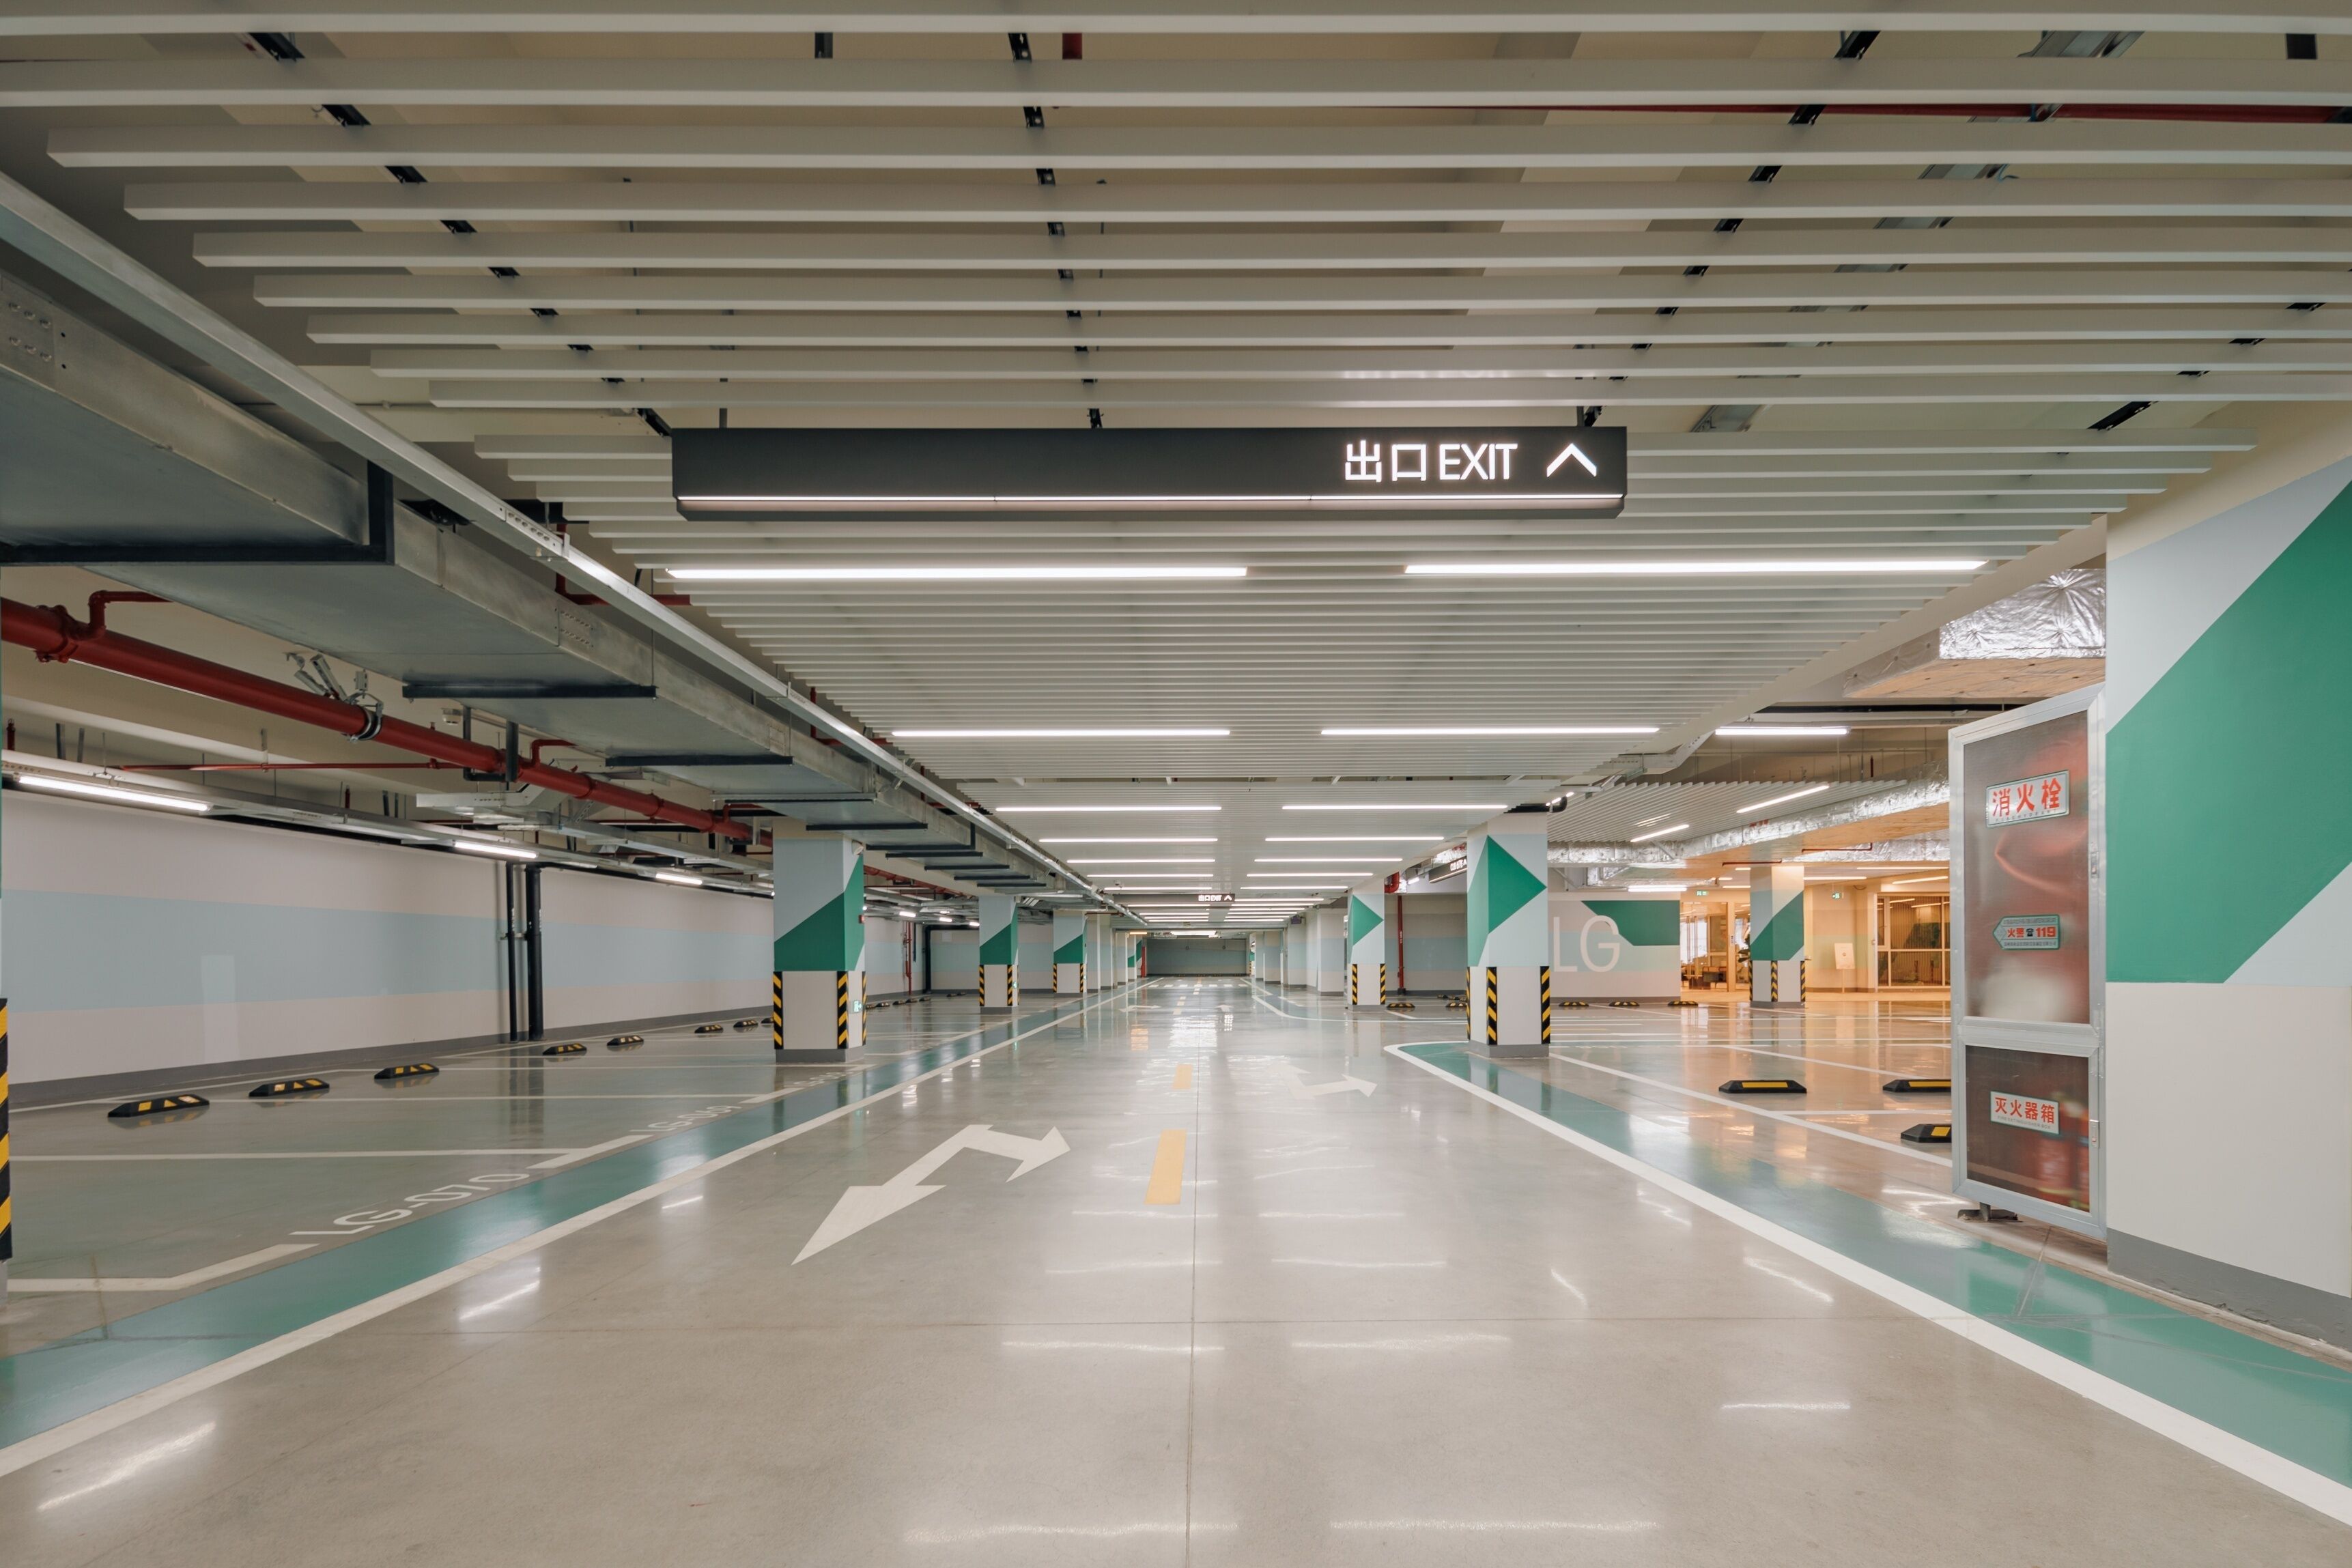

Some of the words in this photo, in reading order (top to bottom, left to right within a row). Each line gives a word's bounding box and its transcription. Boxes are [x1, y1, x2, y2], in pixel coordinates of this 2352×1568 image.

[1345, 440, 1427, 482] 出口
[1439, 443, 1518, 480] EXIT
[1992, 778, 2062, 817] 消火栓
[1553, 915, 1620, 972] LG
[2036, 926, 2056, 937] 119
[629, 1104, 742, 1132] LG-069
[1995, 1097, 2055, 1124] 灭火器箱
[289, 1173, 530, 1235] LG-070
